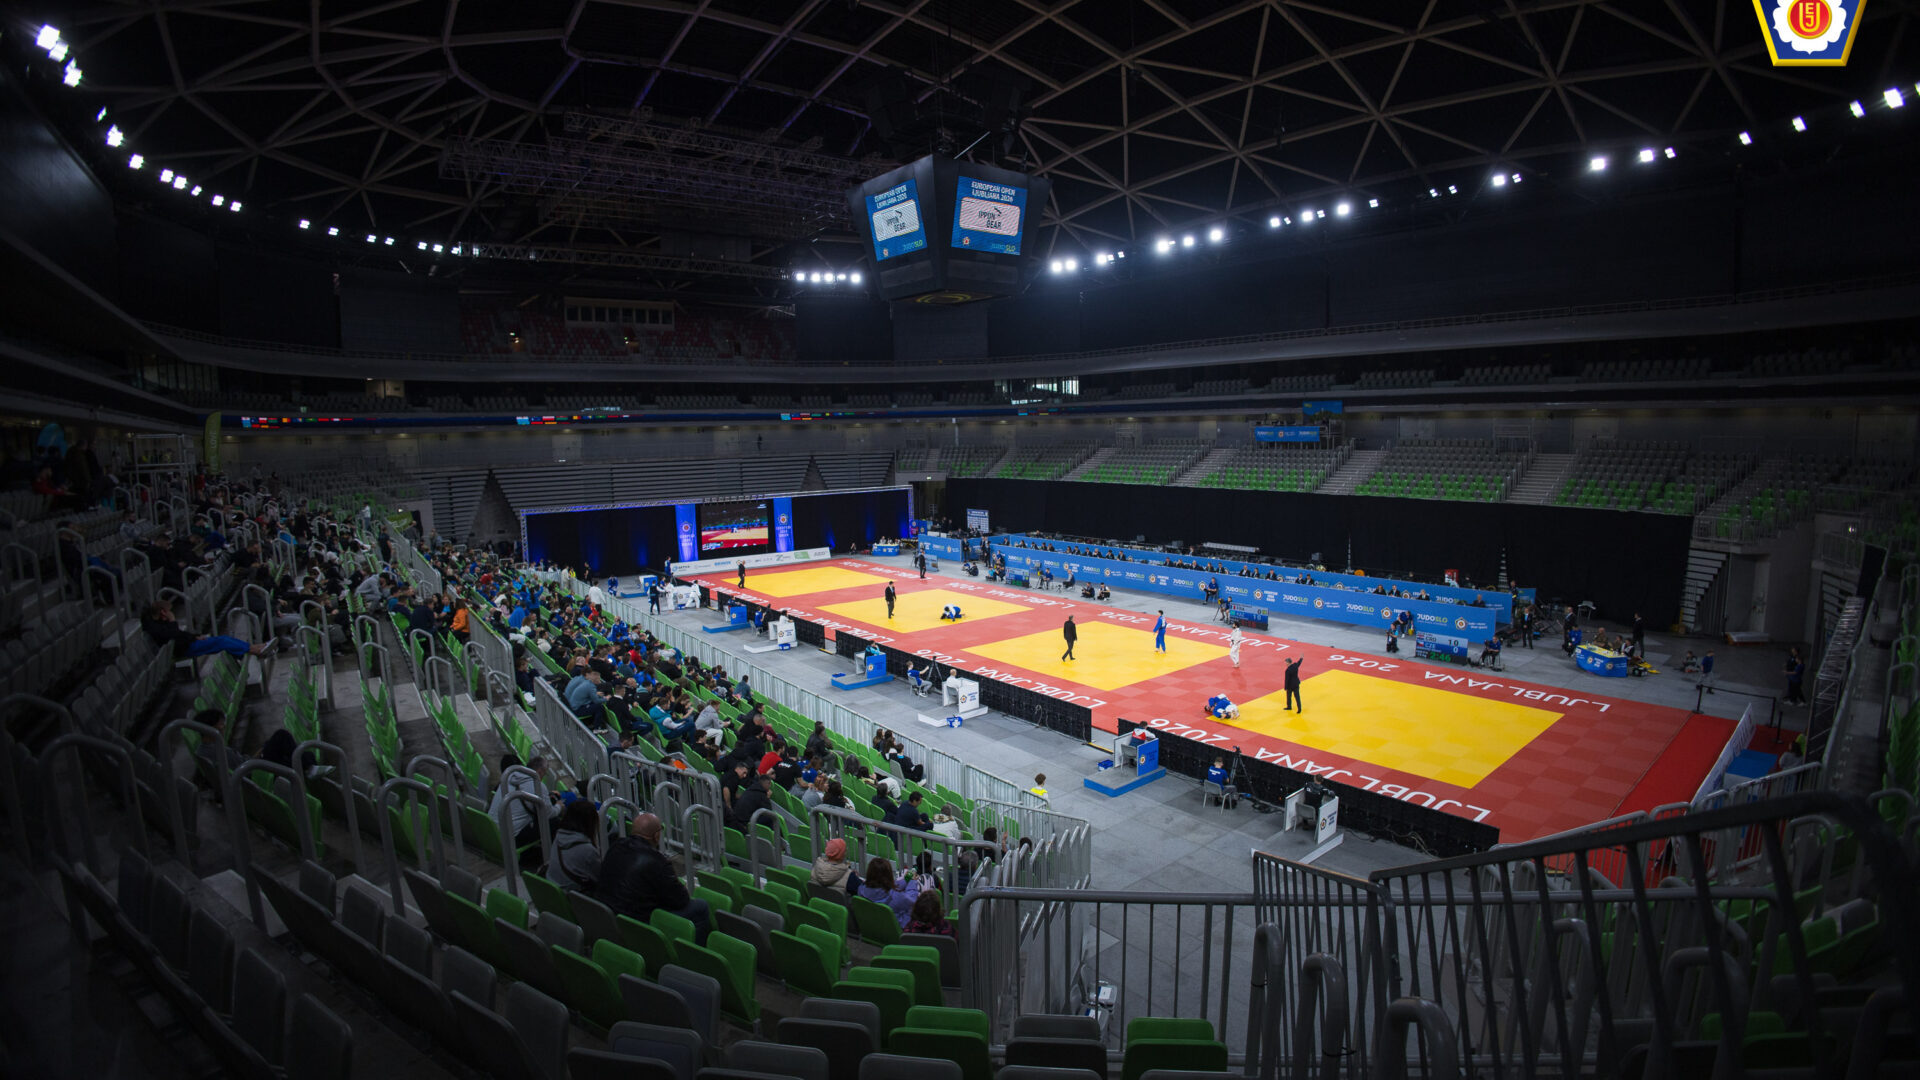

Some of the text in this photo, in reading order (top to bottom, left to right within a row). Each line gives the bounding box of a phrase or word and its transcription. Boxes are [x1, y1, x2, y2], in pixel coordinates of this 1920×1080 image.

[874, 184, 907, 203] EUROPEAN OPEN
[971, 181, 1016, 196] EUROPEAN OPEN
[972, 189, 1014, 203] LJUBLJANA 2026
[979, 211, 996, 220] IPPON
[894, 222, 906, 232] GEAR
[986, 220, 1002, 229] GEAR
[1083, 565, 1101, 573] JUDOSLO
[1173, 578, 1194, 586] JUDOSLO
[1225, 585, 1249, 594] JUDOSLO
[944, 582, 1076, 609] LJUBLJANA 2026
[1283, 594, 1309, 603] JUDOSLO
[1346, 603, 1375, 613] JUDOSLO
[1096, 611, 1151, 624] 2026
[1417, 613, 1448, 623] JUDOSLO
[811, 617, 895, 644] LJUBLJANA
[917, 649, 1107, 709] LJUBLJANA 2026
[1327, 653, 1611, 713] LJUBLJANA 2026
[1149, 718, 1492, 823] LJUBLJANA 2026
